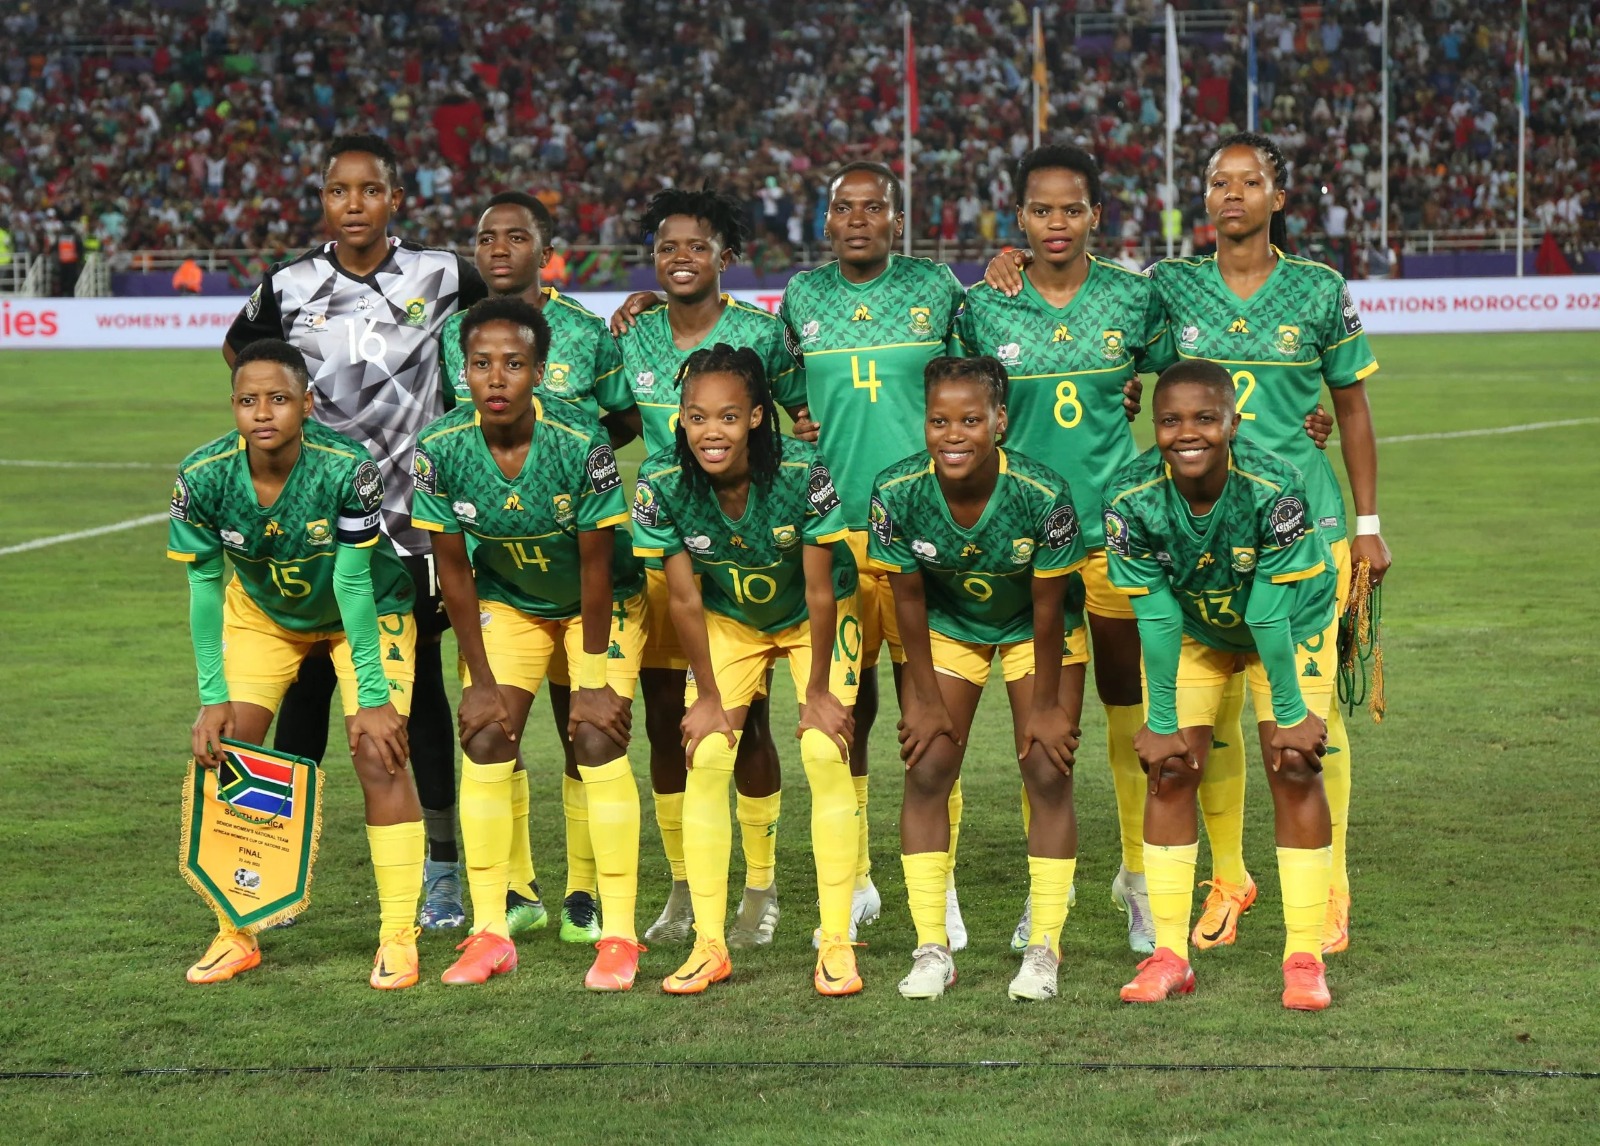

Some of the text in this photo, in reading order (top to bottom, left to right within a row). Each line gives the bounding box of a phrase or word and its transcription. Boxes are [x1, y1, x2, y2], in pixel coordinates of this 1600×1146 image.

[3, 302, 58, 337] ies
[95, 312, 181, 329] WOMEN'S
[1359, 296, 1447, 313] NATIONS
[1453, 294, 1558, 312] MOROCCO
[345, 316, 387, 364] 16
[851, 355, 882, 403] 4
[1053, 380, 1083, 429] 8
[502, 542, 551, 572] 14
[268, 562, 311, 597] 15
[728, 567, 777, 604] 10
[1193, 595, 1242, 628] 13
[216, 820, 233, 829] SENIOR
[233, 823, 254, 834] WOMEN'S
[255, 830, 276, 840] NATIONAL
[238, 846, 262, 859] FINAL
